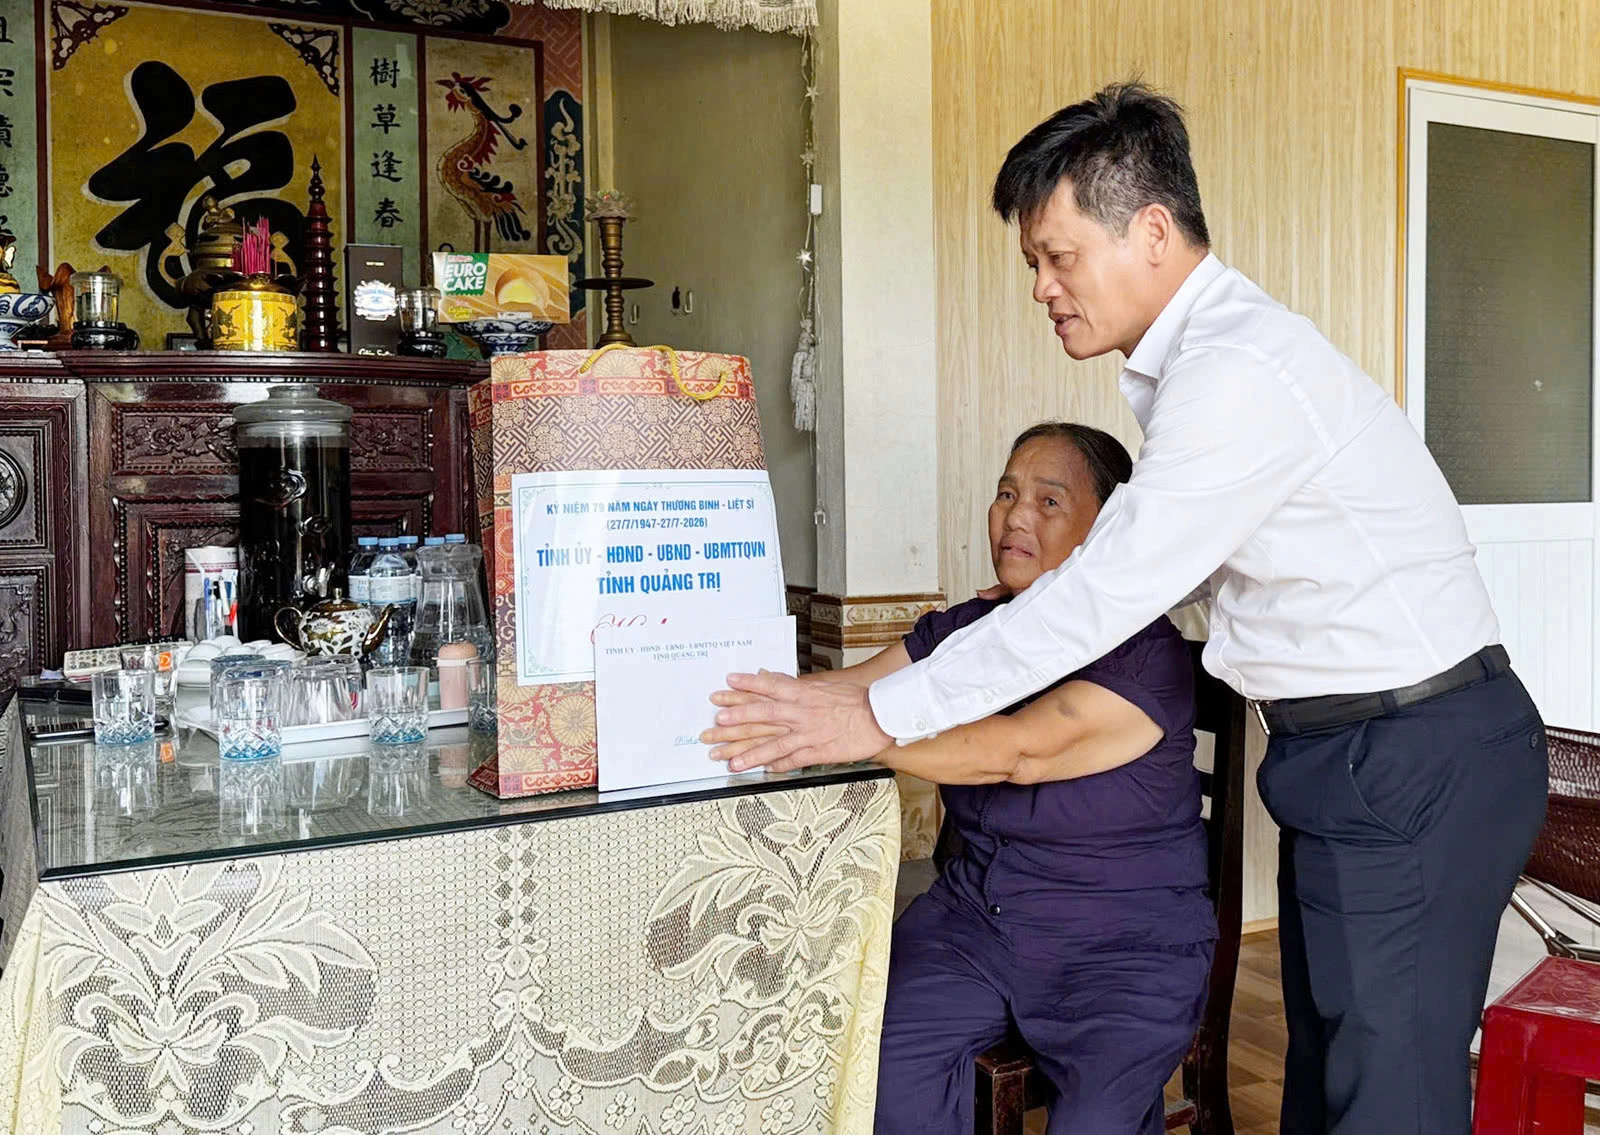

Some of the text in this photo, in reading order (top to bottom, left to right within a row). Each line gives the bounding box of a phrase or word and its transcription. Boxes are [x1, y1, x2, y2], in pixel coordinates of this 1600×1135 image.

[369, 57, 403, 228] 樹草逢春
[445, 262, 487, 277] EURO
[443, 276, 485, 291] CAKE
[607, 499, 630, 512] NĂM
[633, 499, 658, 511] NGÀY
[660, 500, 697, 511] THƯƠNG
[699, 500, 720, 510] BINH
[606, 517, 708, 531] (27/7/1947-27/7-2026)
[536, 543, 570, 567] TỈNH
[575, 541, 592, 565] ỦY
[606, 545, 644, 563] HĐND
[657, 543, 691, 561] UBND
[704, 541, 766, 560] UBMTTQVN
[597, 568, 721, 594] TỈNH QUẢNG TRỊ
